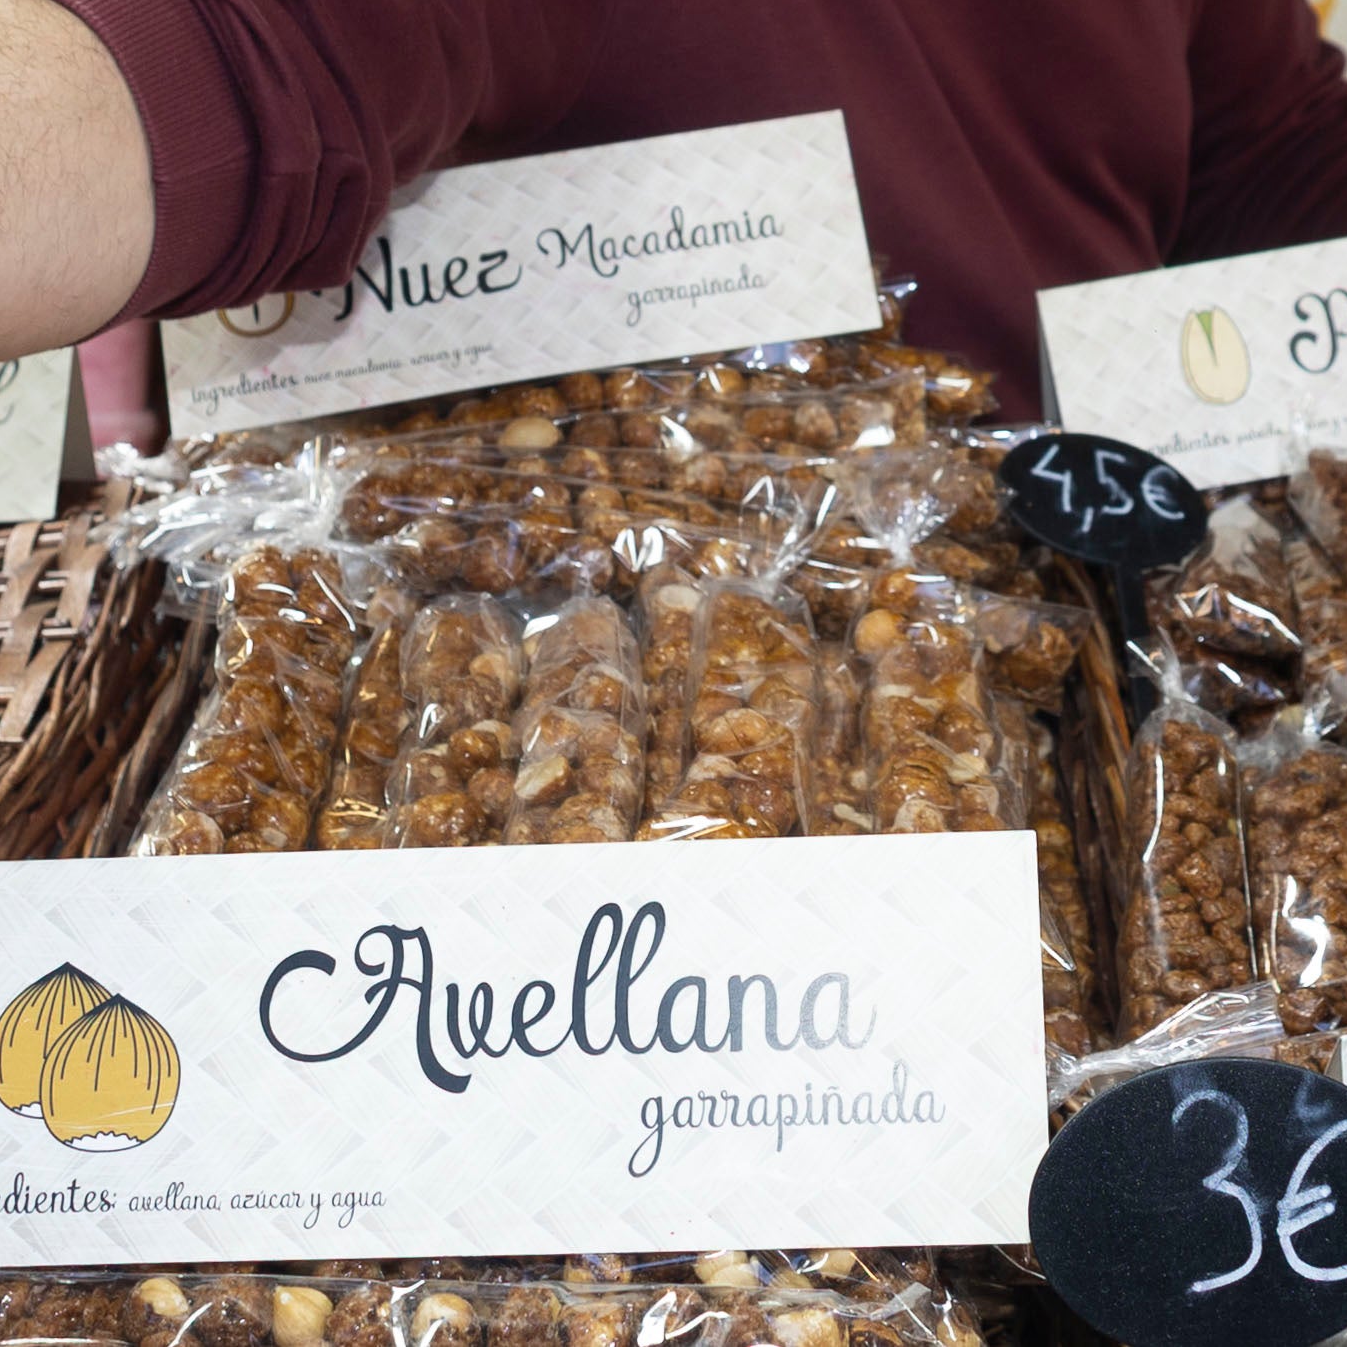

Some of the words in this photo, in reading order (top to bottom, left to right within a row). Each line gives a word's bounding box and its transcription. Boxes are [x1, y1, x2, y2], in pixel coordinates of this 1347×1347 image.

[310, 236, 521, 321] Nuez
[537, 205, 785, 278] Macadamia
[626, 264, 769, 327] garrapiñada
[1031, 443, 1186, 534] 4,5€
[259, 900, 878, 1094] Avellana
[627, 1058, 947, 1178] garrapiñada
[230, 1189, 305, 1209] azúcar
[302, 1192, 326, 1230] y
[331, 1191, 388, 1230] agua
